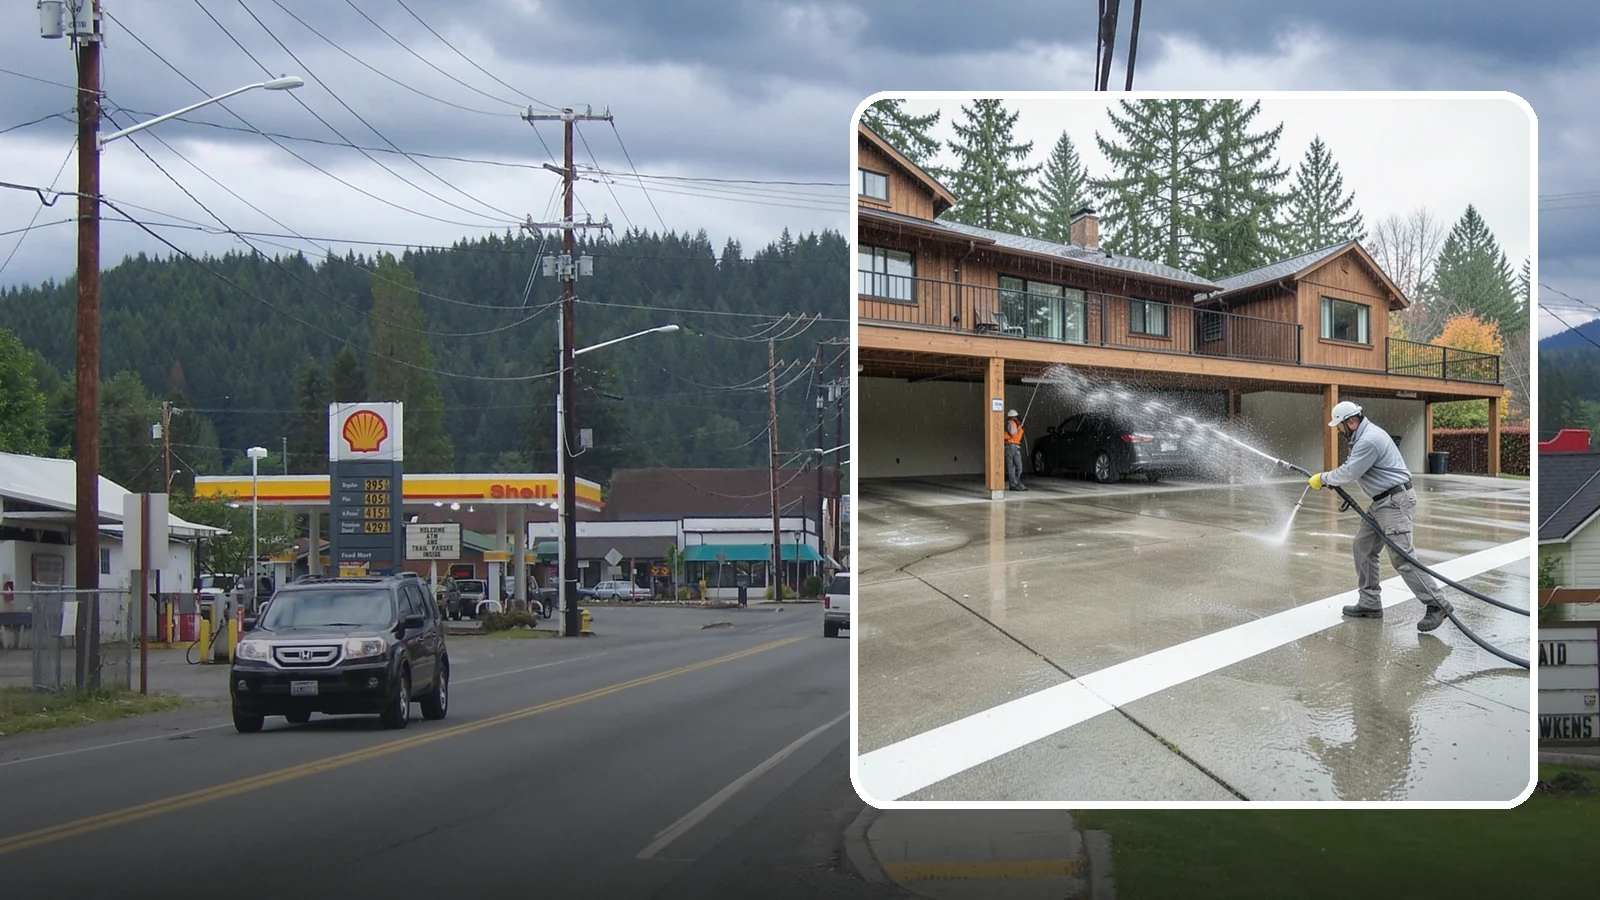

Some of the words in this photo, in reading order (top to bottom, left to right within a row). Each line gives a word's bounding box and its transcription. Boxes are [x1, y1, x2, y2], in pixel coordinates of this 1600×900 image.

[365, 480, 384, 490] 395
[490, 484, 547, 499] Shell
[365, 494, 384, 504] 405
[365, 508, 384, 518] 415
[365, 522, 384, 532] 429
